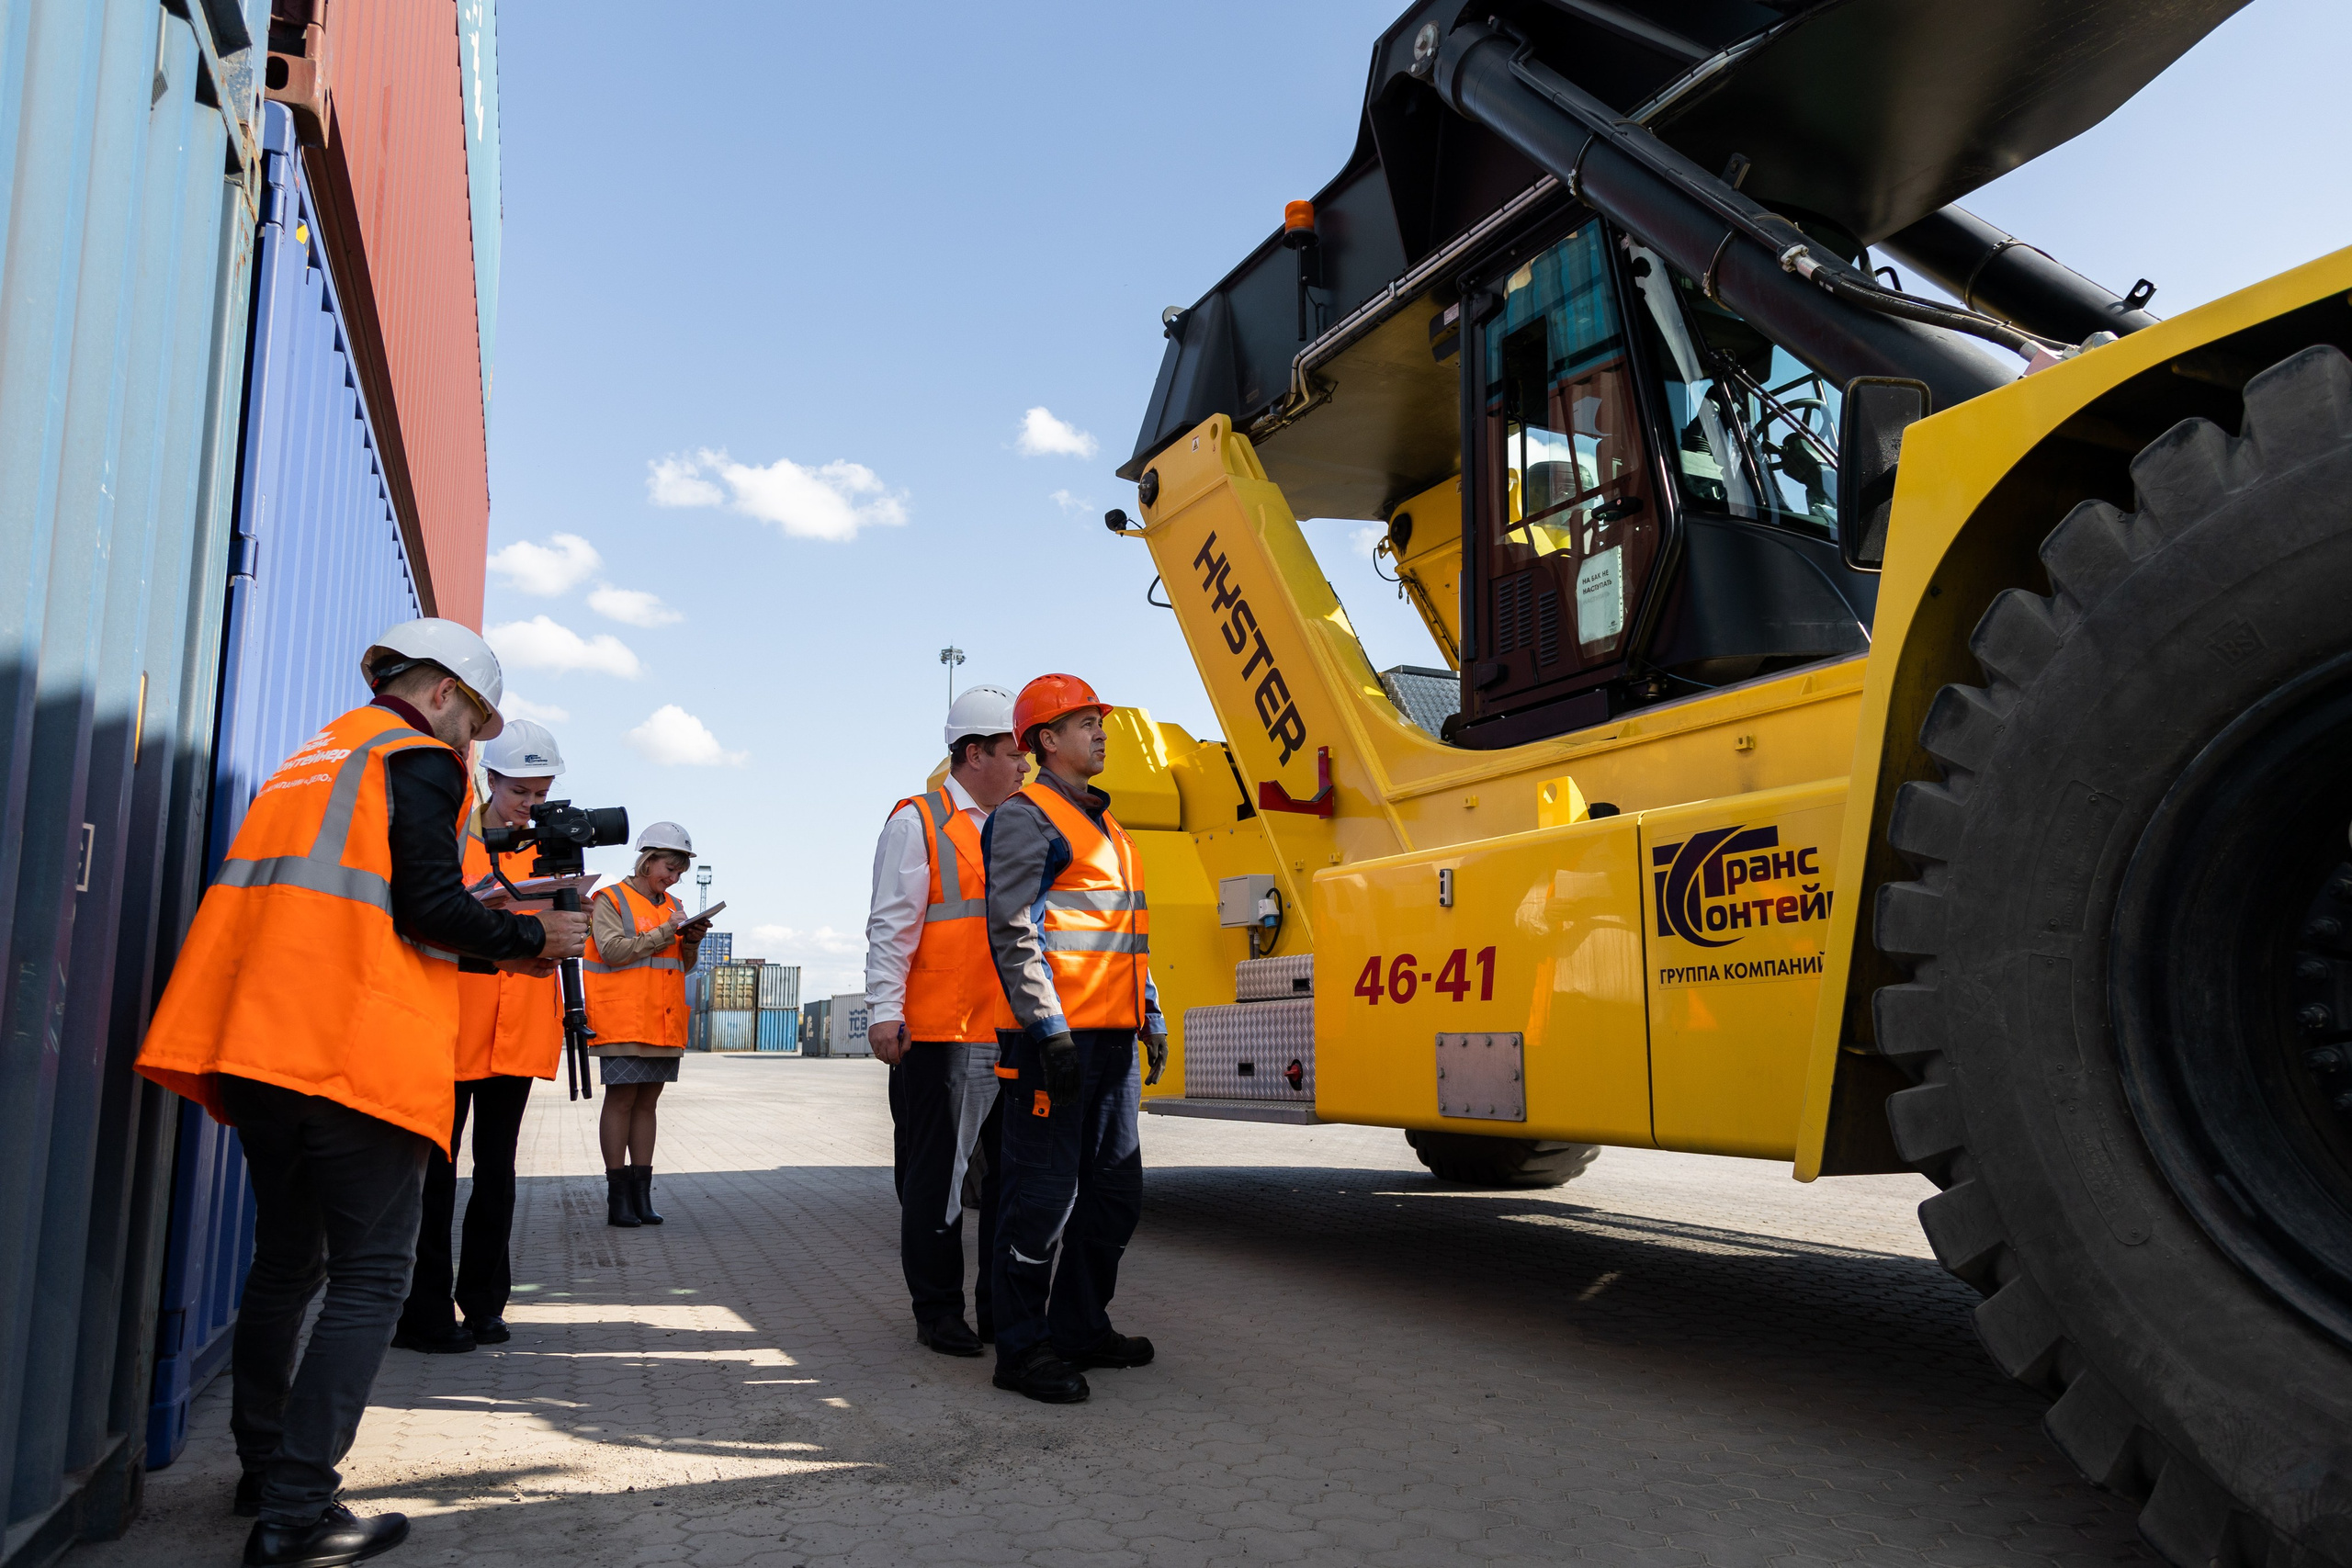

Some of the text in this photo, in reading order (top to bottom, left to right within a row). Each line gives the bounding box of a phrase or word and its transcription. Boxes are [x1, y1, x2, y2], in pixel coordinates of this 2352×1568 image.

[1582, 570, 1610, 585] НА БАК НЕ
[1582, 579, 1612, 595] НАСТУПАТЬ
[1193, 530, 1306, 768] HYSTER
[1354, 946, 1496, 1005] 46-41
[1660, 964, 1720, 985] ГРУППА
